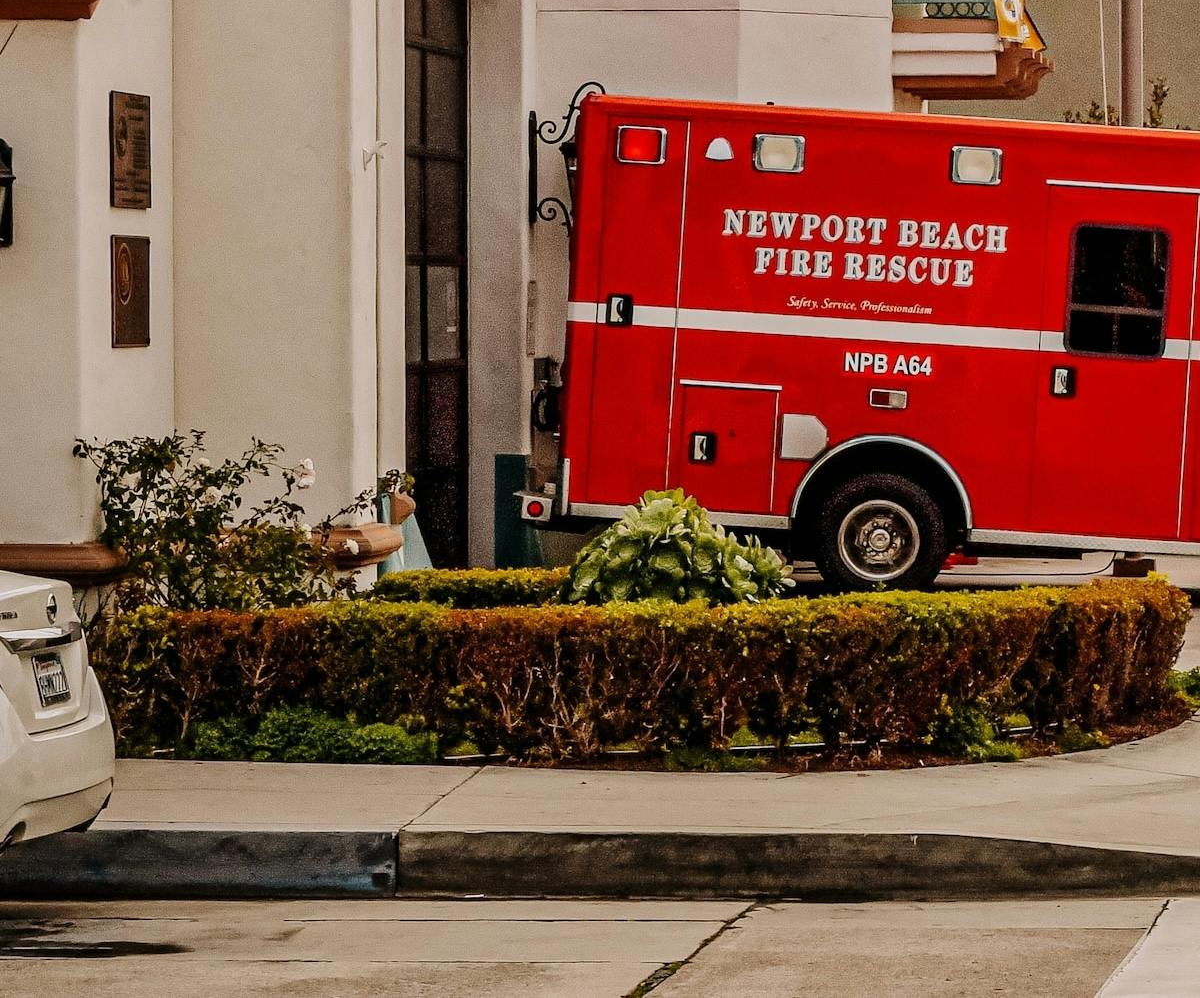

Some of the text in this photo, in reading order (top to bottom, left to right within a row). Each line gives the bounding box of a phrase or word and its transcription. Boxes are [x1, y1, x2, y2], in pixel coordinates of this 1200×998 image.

[722, 209, 1008, 253] NEWPORT BEACH
[754, 247, 974, 287] FIRE RESCUE
[860, 300, 932, 314] Professionalism
[844, 352, 932, 376] NPB A64
